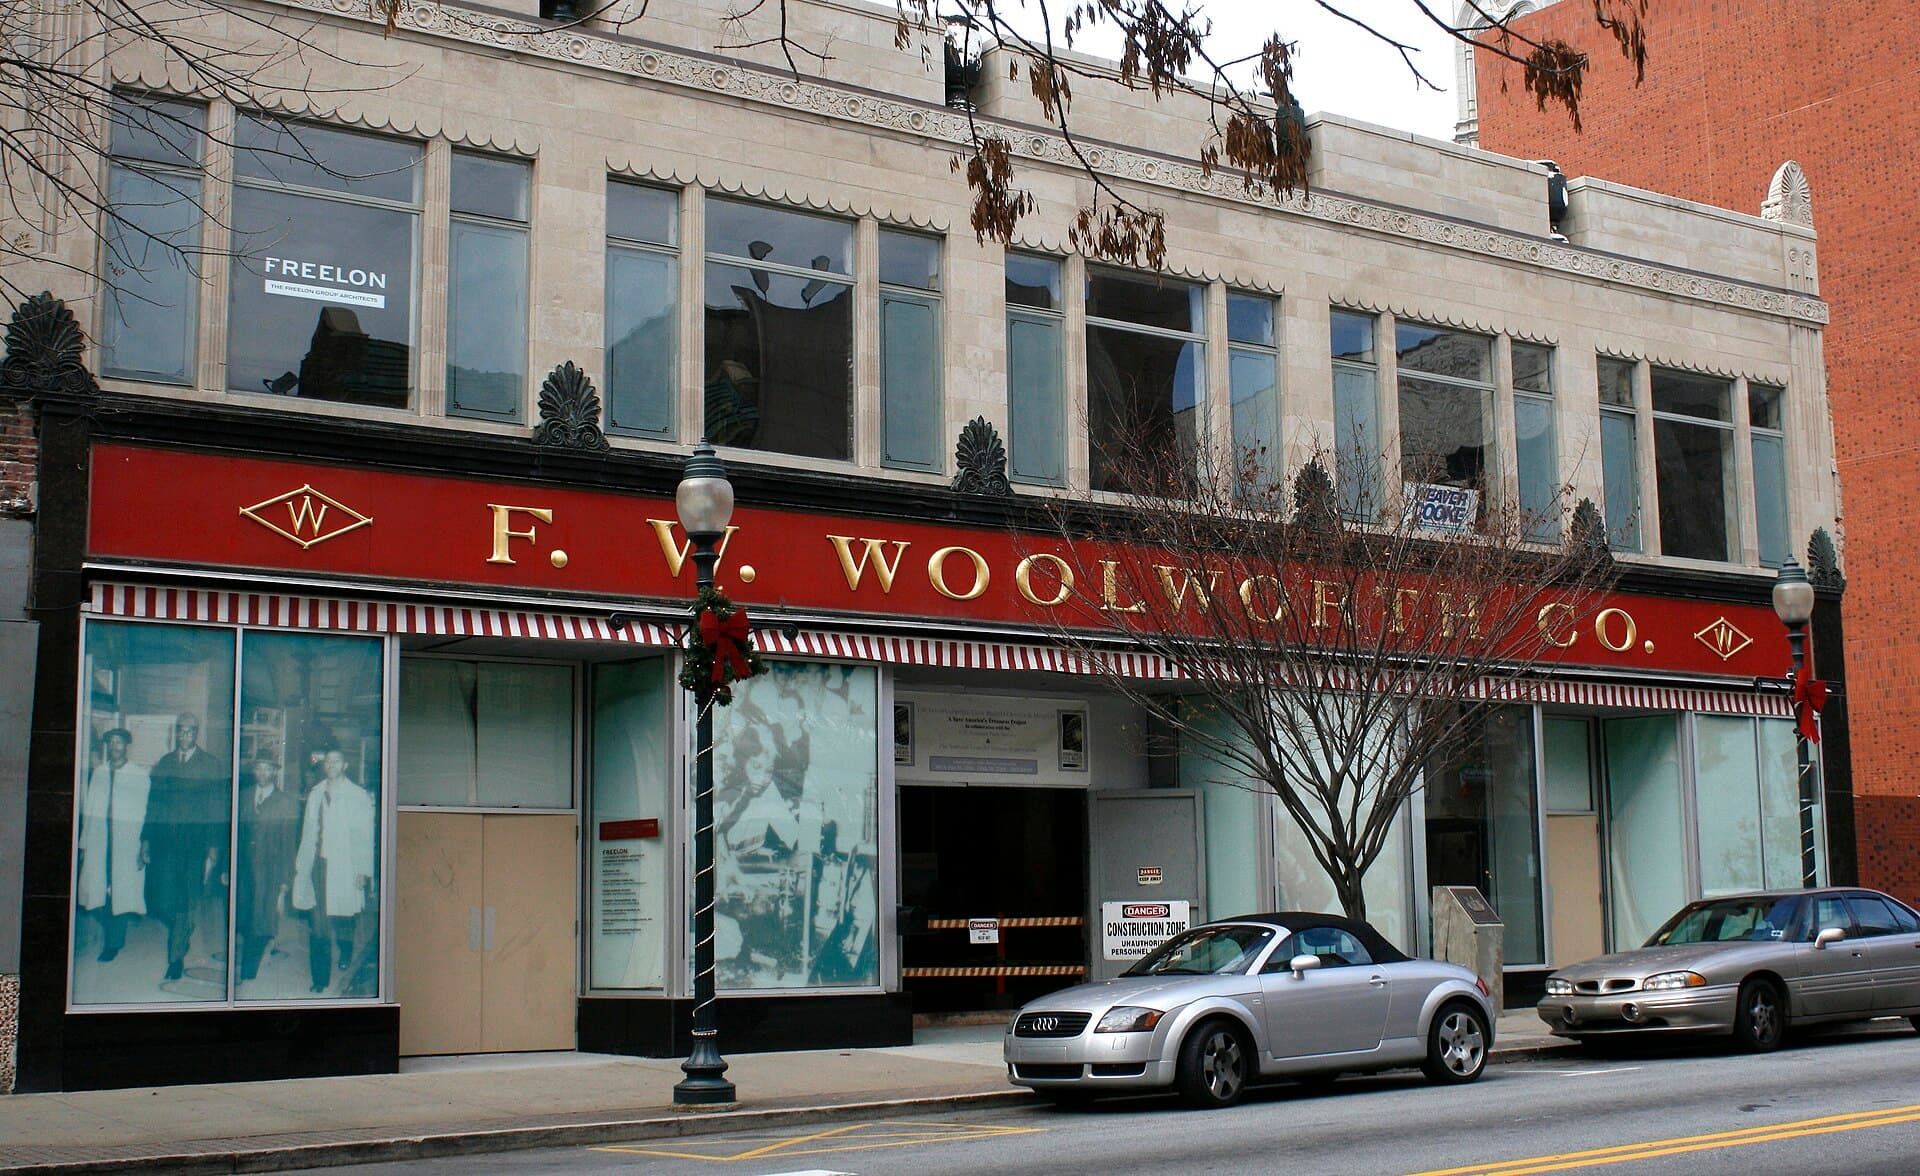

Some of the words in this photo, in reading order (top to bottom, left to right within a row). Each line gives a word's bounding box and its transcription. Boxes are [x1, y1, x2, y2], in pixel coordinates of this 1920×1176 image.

[265, 256, 386, 289] FREELON
[284, 286, 314, 295] FREELON
[340, 293, 378, 302] ARCHITECTS
[286, 496, 328, 537] W
[486, 503, 569, 569] F.
[826, 533, 1485, 640] WOOLWORTH
[1537, 602, 1656, 655] CO.
[1127, 907, 1165, 915] DANGER
[1107, 922, 1165, 936] CONSTRUCTION
[1111, 948, 1149, 956] PERSONNEL
